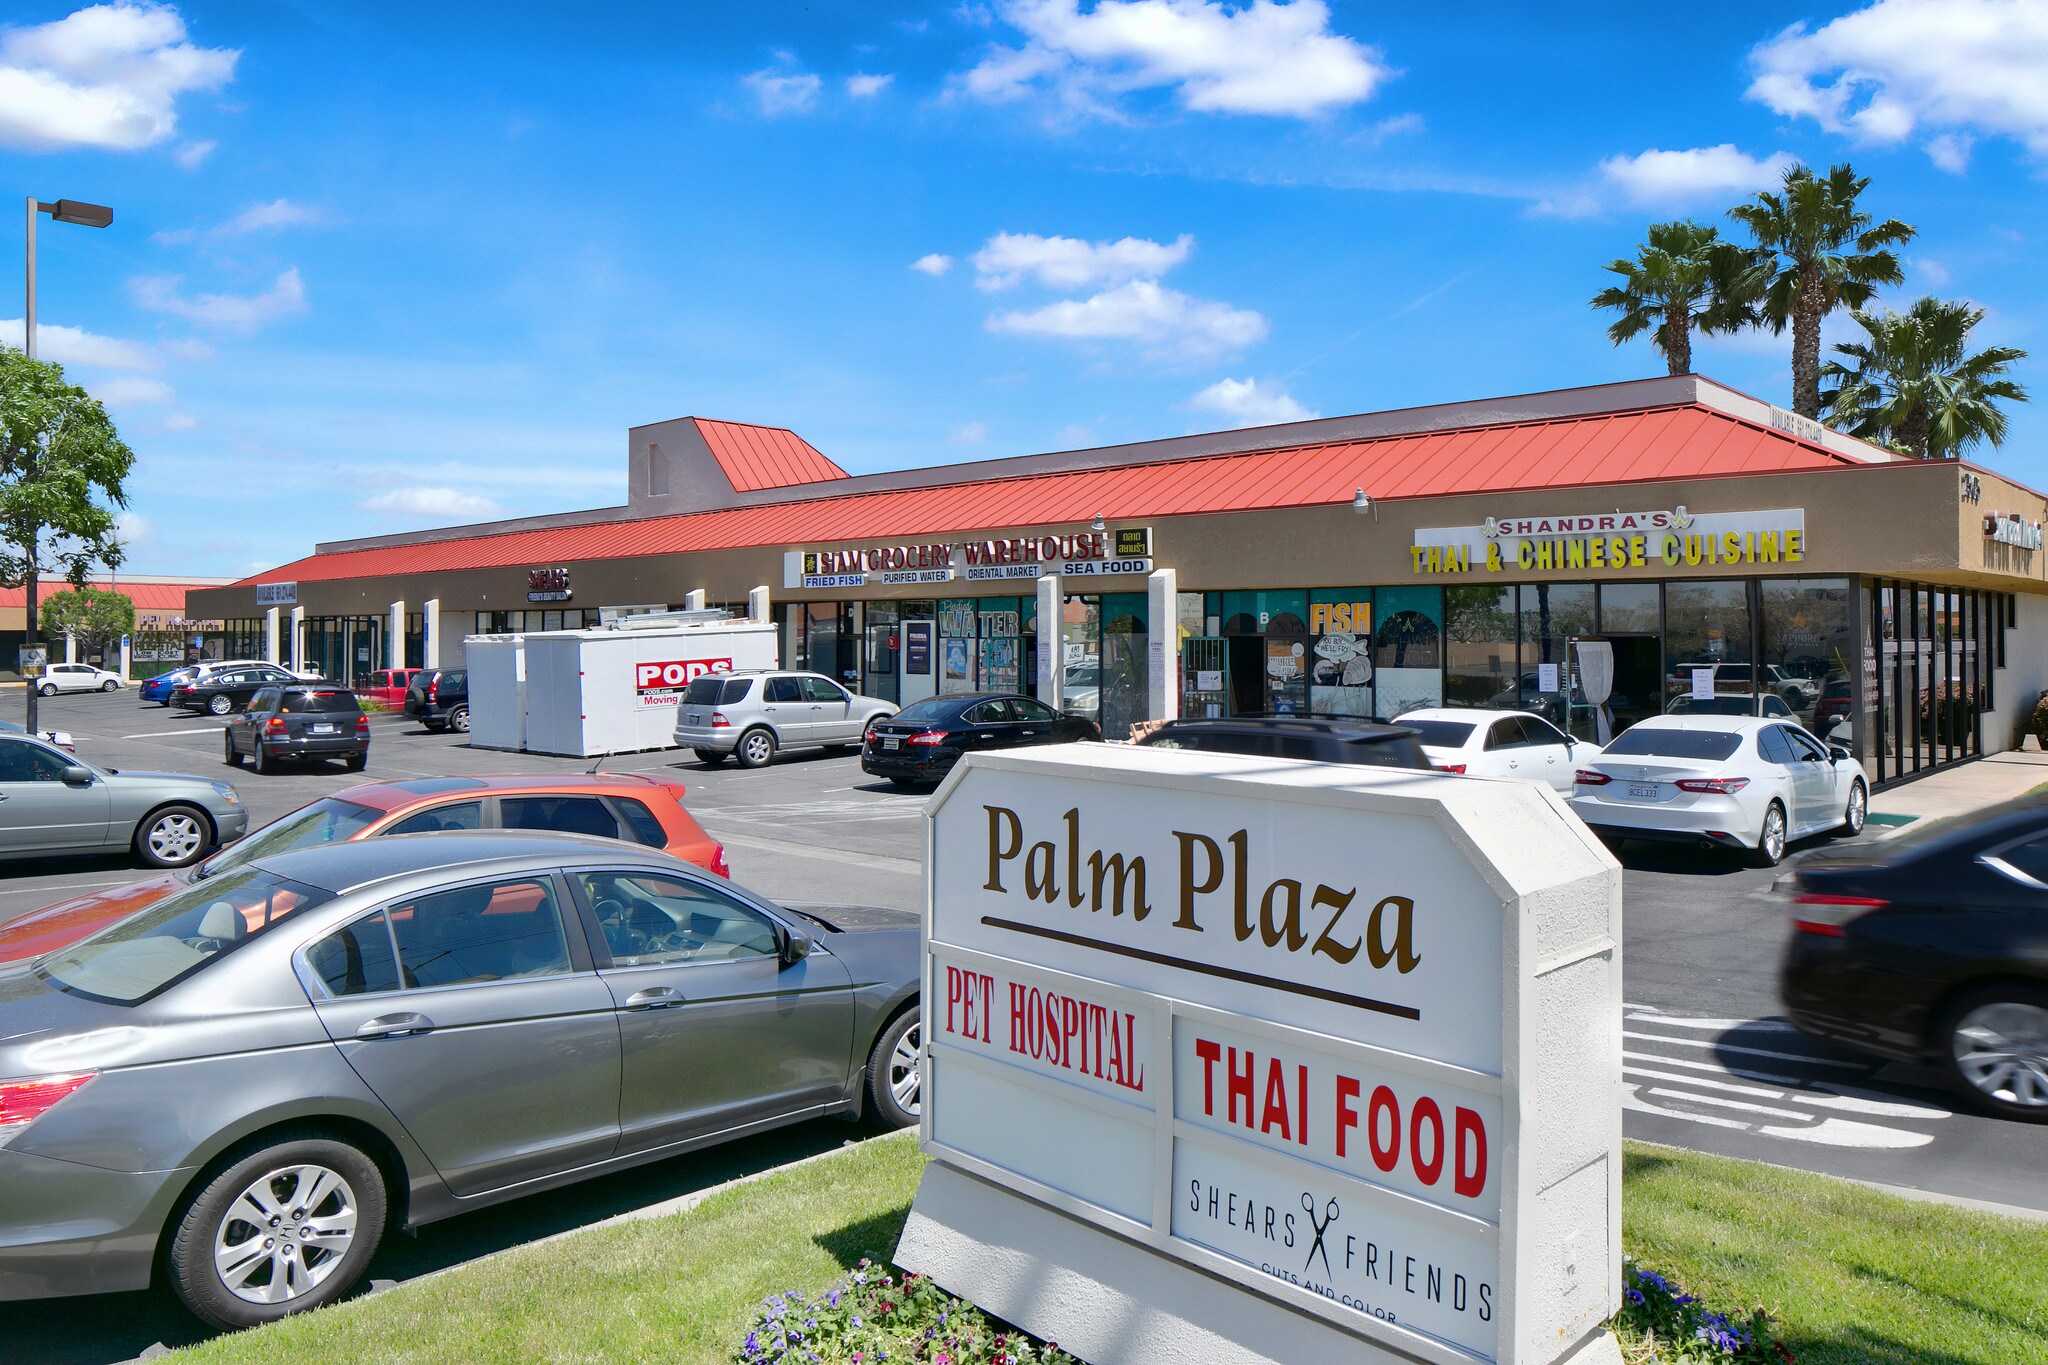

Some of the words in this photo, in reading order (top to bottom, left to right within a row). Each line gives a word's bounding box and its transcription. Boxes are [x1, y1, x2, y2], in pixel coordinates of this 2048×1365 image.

[1500, 514, 1668, 535] SHANDRA'S
[821, 550, 864, 574] SIAM
[868, 543, 954, 572] GROCERY
[963, 534, 1106, 565] WAREHOUSE
[1411, 544, 1468, 573] THAI
[1486, 542, 1502, 572] &
[1518, 536, 1646, 570] CHINESE
[1662, 530, 1801, 567] CUISINE
[884, 572, 917, 583] PURIFIED
[920, 570, 946, 582] WATER
[968, 568, 1004, 579] ORIENTAL
[1006, 566, 1039, 578] MARKET
[1064, 563, 1095, 575] SEA
[1102, 561, 1145, 573] FOOD
[528, 568, 569, 590] SHEARS
[806, 577, 836, 587] FRIED
[838, 575, 863, 586] FISH
[140, 614, 160, 627] PET
[938, 611, 1019, 637] WATER
[1260, 612, 1270, 624] B
[1310, 602, 1371, 635] FISH
[1776, 633, 1820, 643] SAPPORO
[1384, 650, 1433, 666] FOOD
[644, 688, 674, 696] PODS.com
[644, 696, 678, 705] Moving
[982, 804, 1152, 922] Palm
[1172, 828, 1422, 975] Plaza
[946, 965, 995, 1044] PET
[1008, 981, 1144, 1092] HOSPITAL
[1195, 1037, 1308, 1146] THAI
[1336, 1074, 1488, 1199] FOOD
[1190, 1179, 1295, 1248] SHEARS
[1346, 1234, 1492, 1322] FRIENDS
[1261, 1262, 1298, 1285] CUTS
[1304, 1279, 1335, 1300] AND
[1341, 1294, 1397, 1324] COLOR
